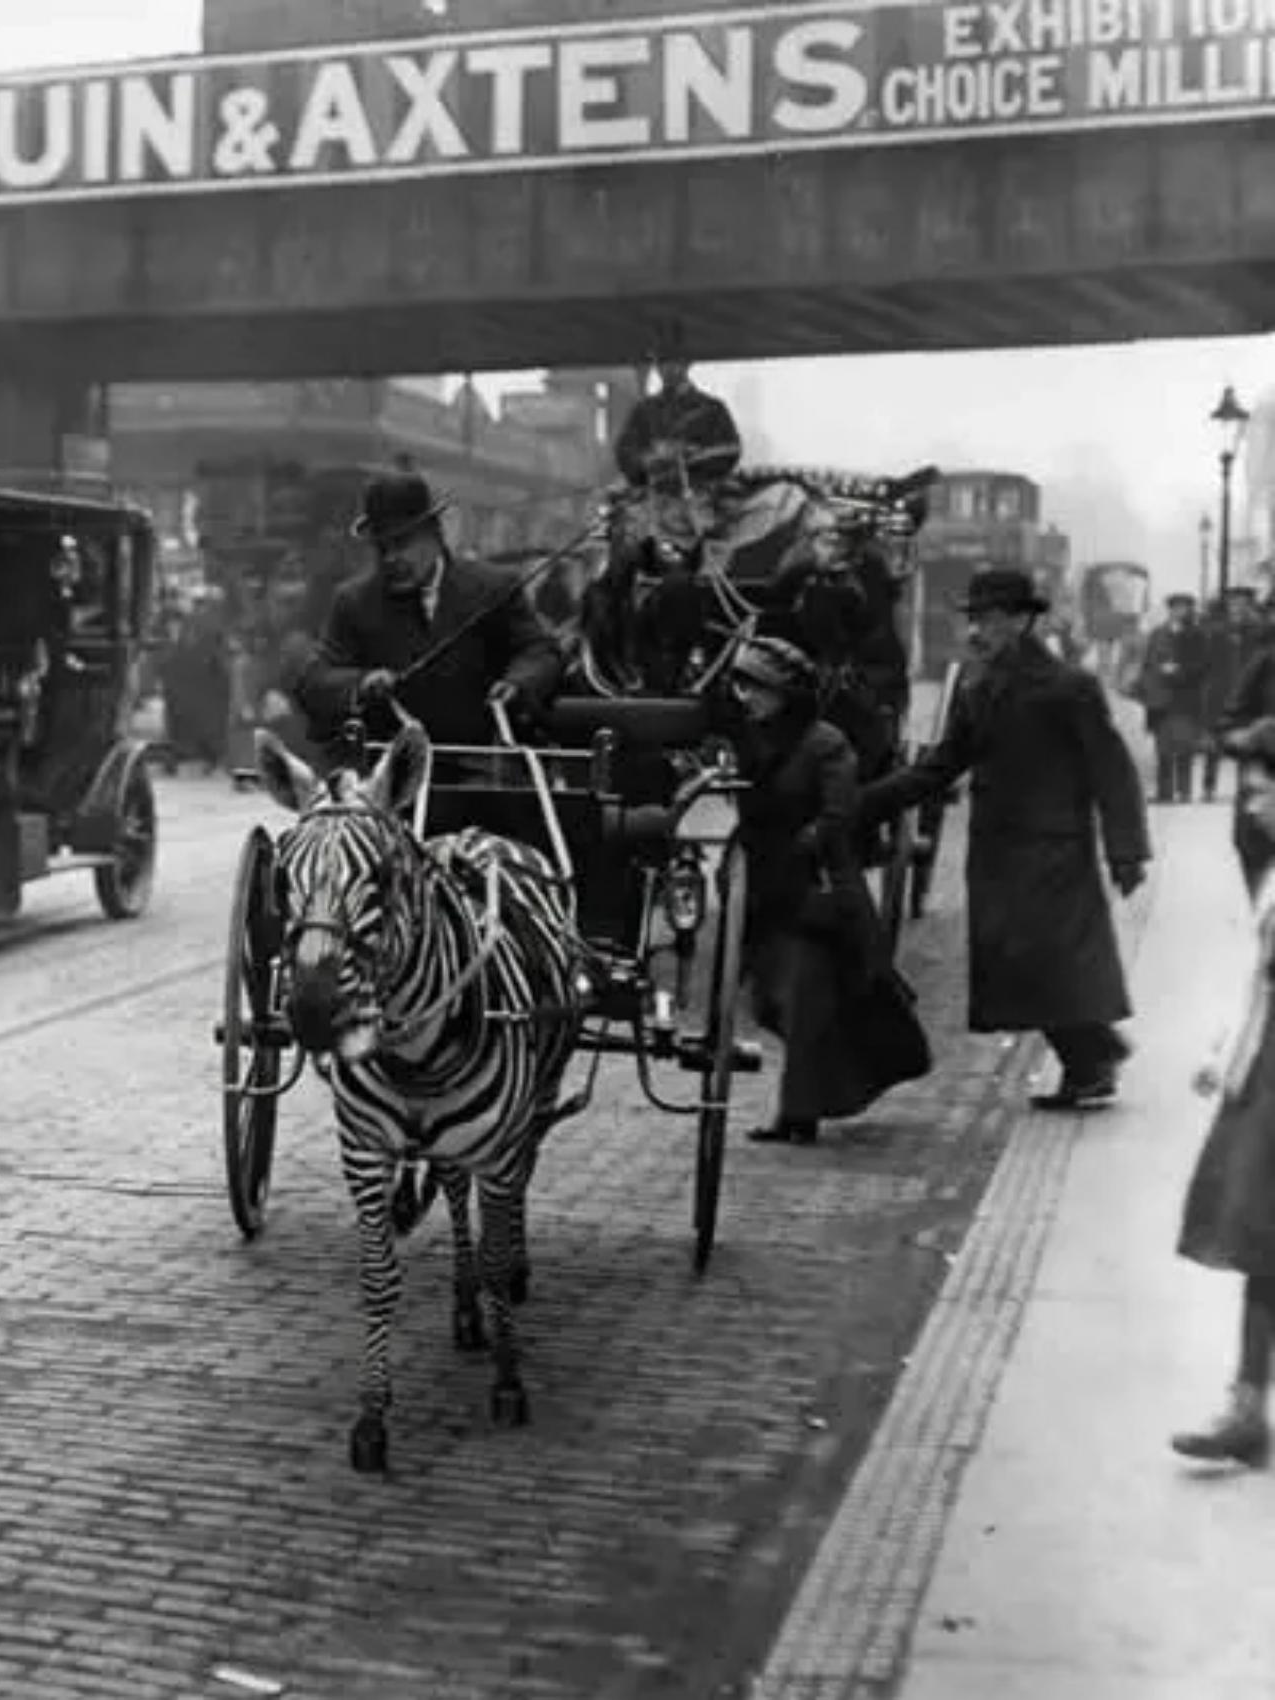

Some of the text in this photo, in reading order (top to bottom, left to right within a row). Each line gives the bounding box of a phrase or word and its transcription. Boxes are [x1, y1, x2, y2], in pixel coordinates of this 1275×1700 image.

[213, 87, 281, 174] &
[289, 18, 868, 168] AXTENS
[882, 38, 1275, 125] CHOICE MILLI
